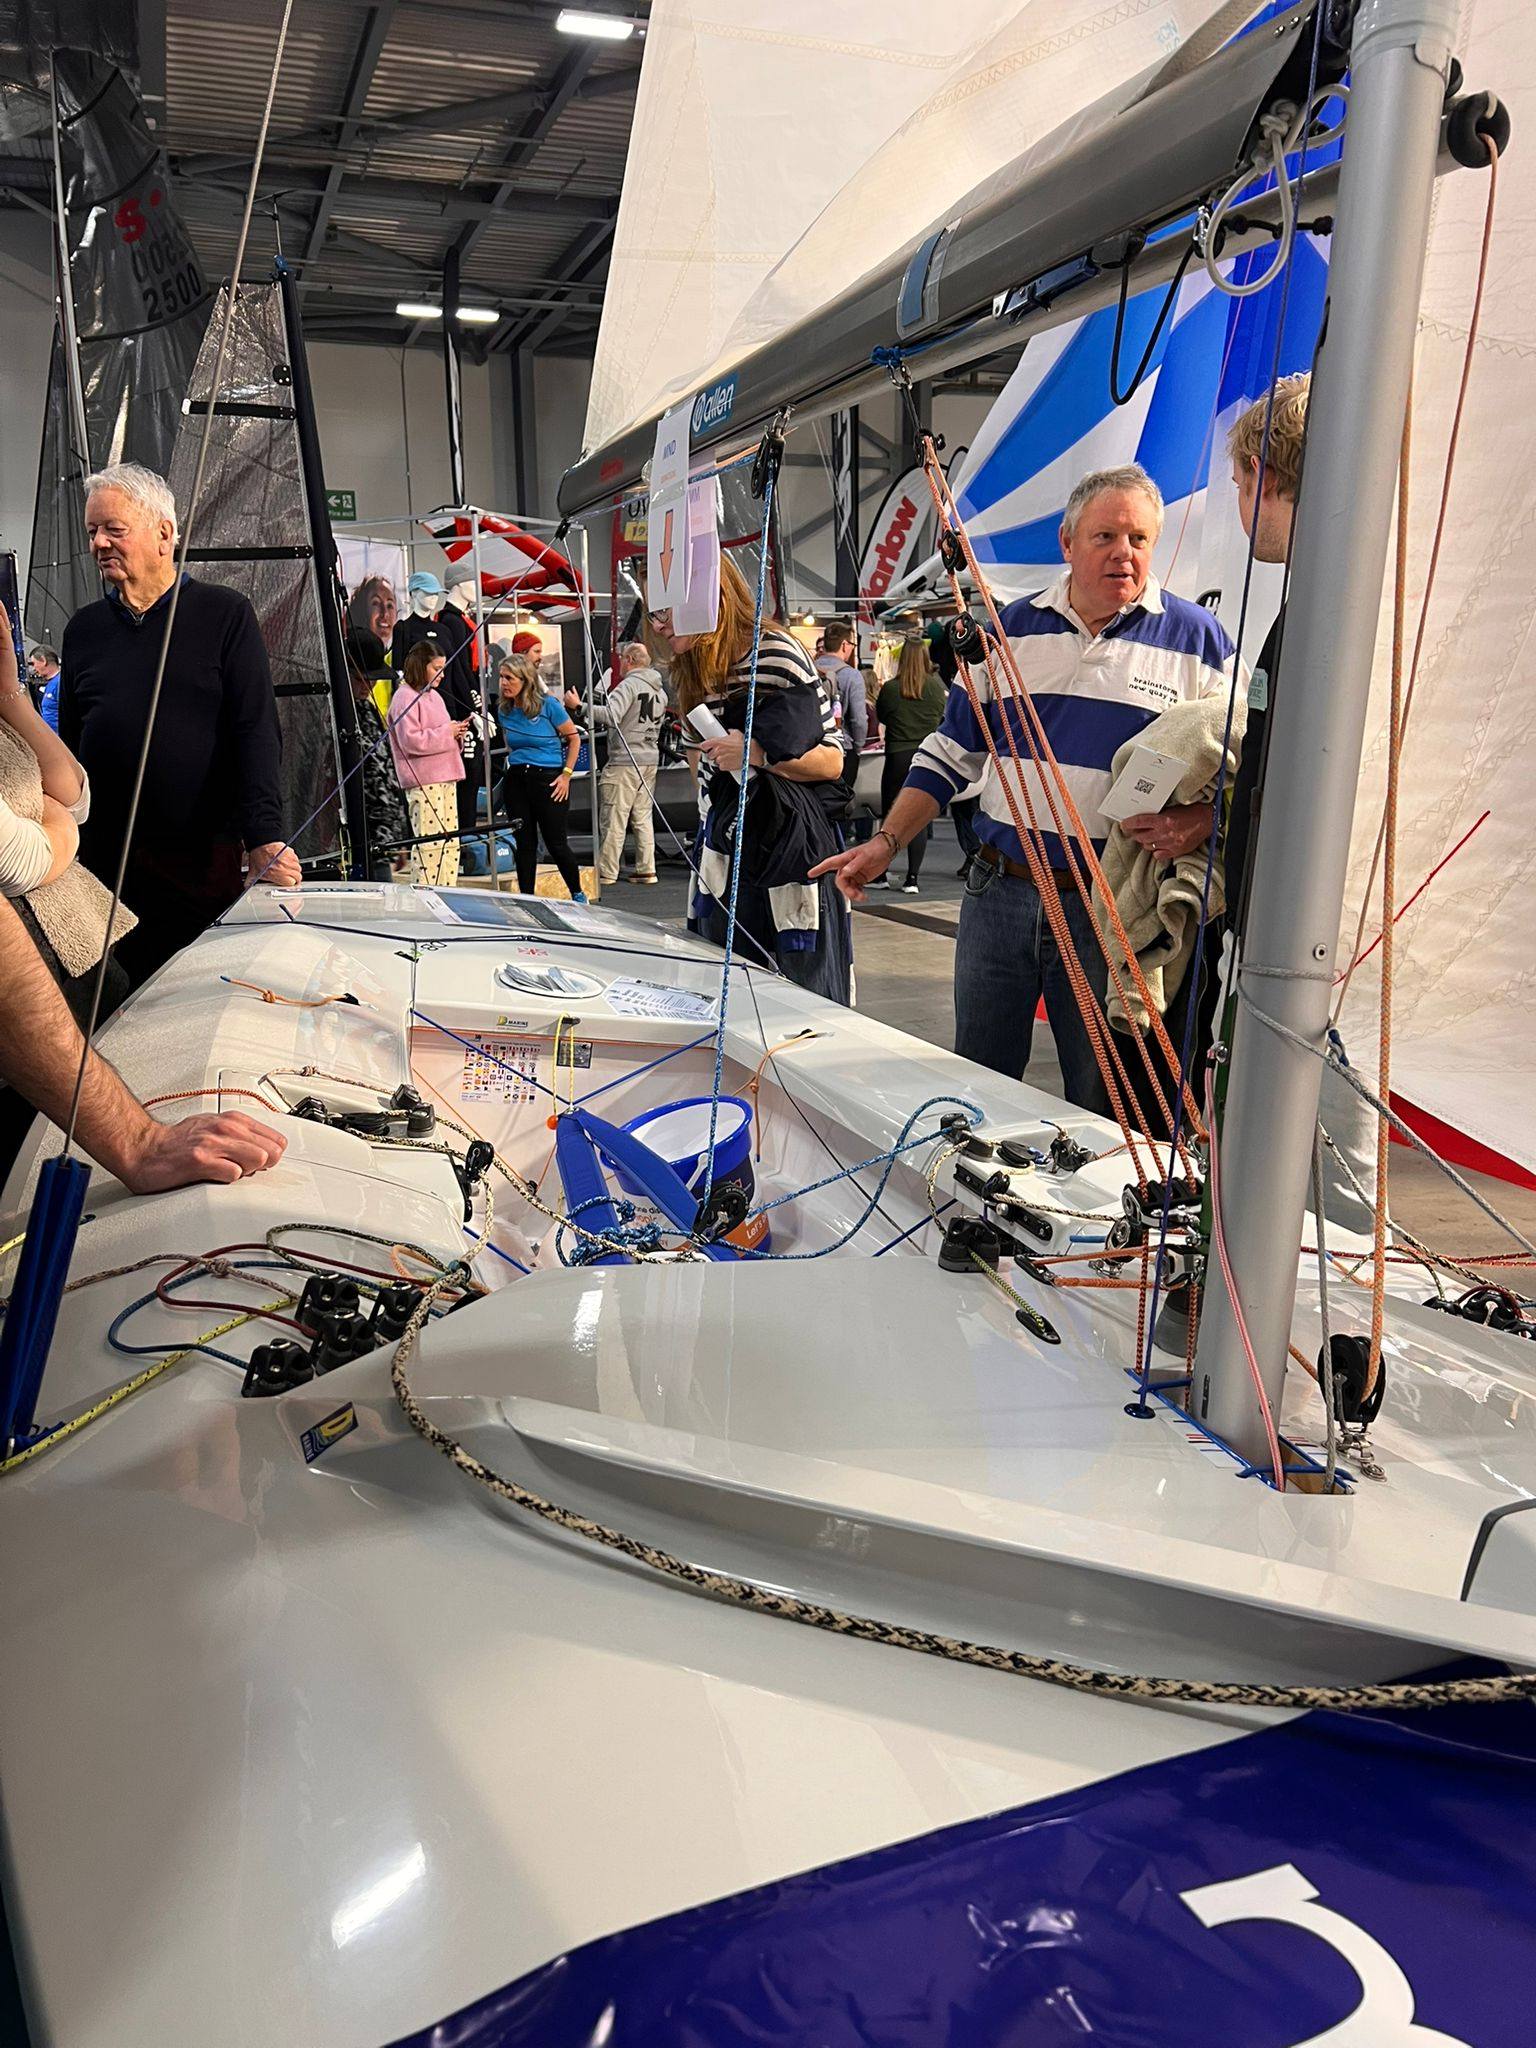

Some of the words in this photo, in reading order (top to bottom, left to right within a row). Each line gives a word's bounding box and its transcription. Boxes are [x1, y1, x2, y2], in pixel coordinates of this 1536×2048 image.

[142, 262, 202, 322] 2500
[703, 383, 735, 424] allen
[1128, 683, 1147, 692] new
[1149, 688, 1168, 700] quay
[1133, 676, 1178, 696] brainstorm
